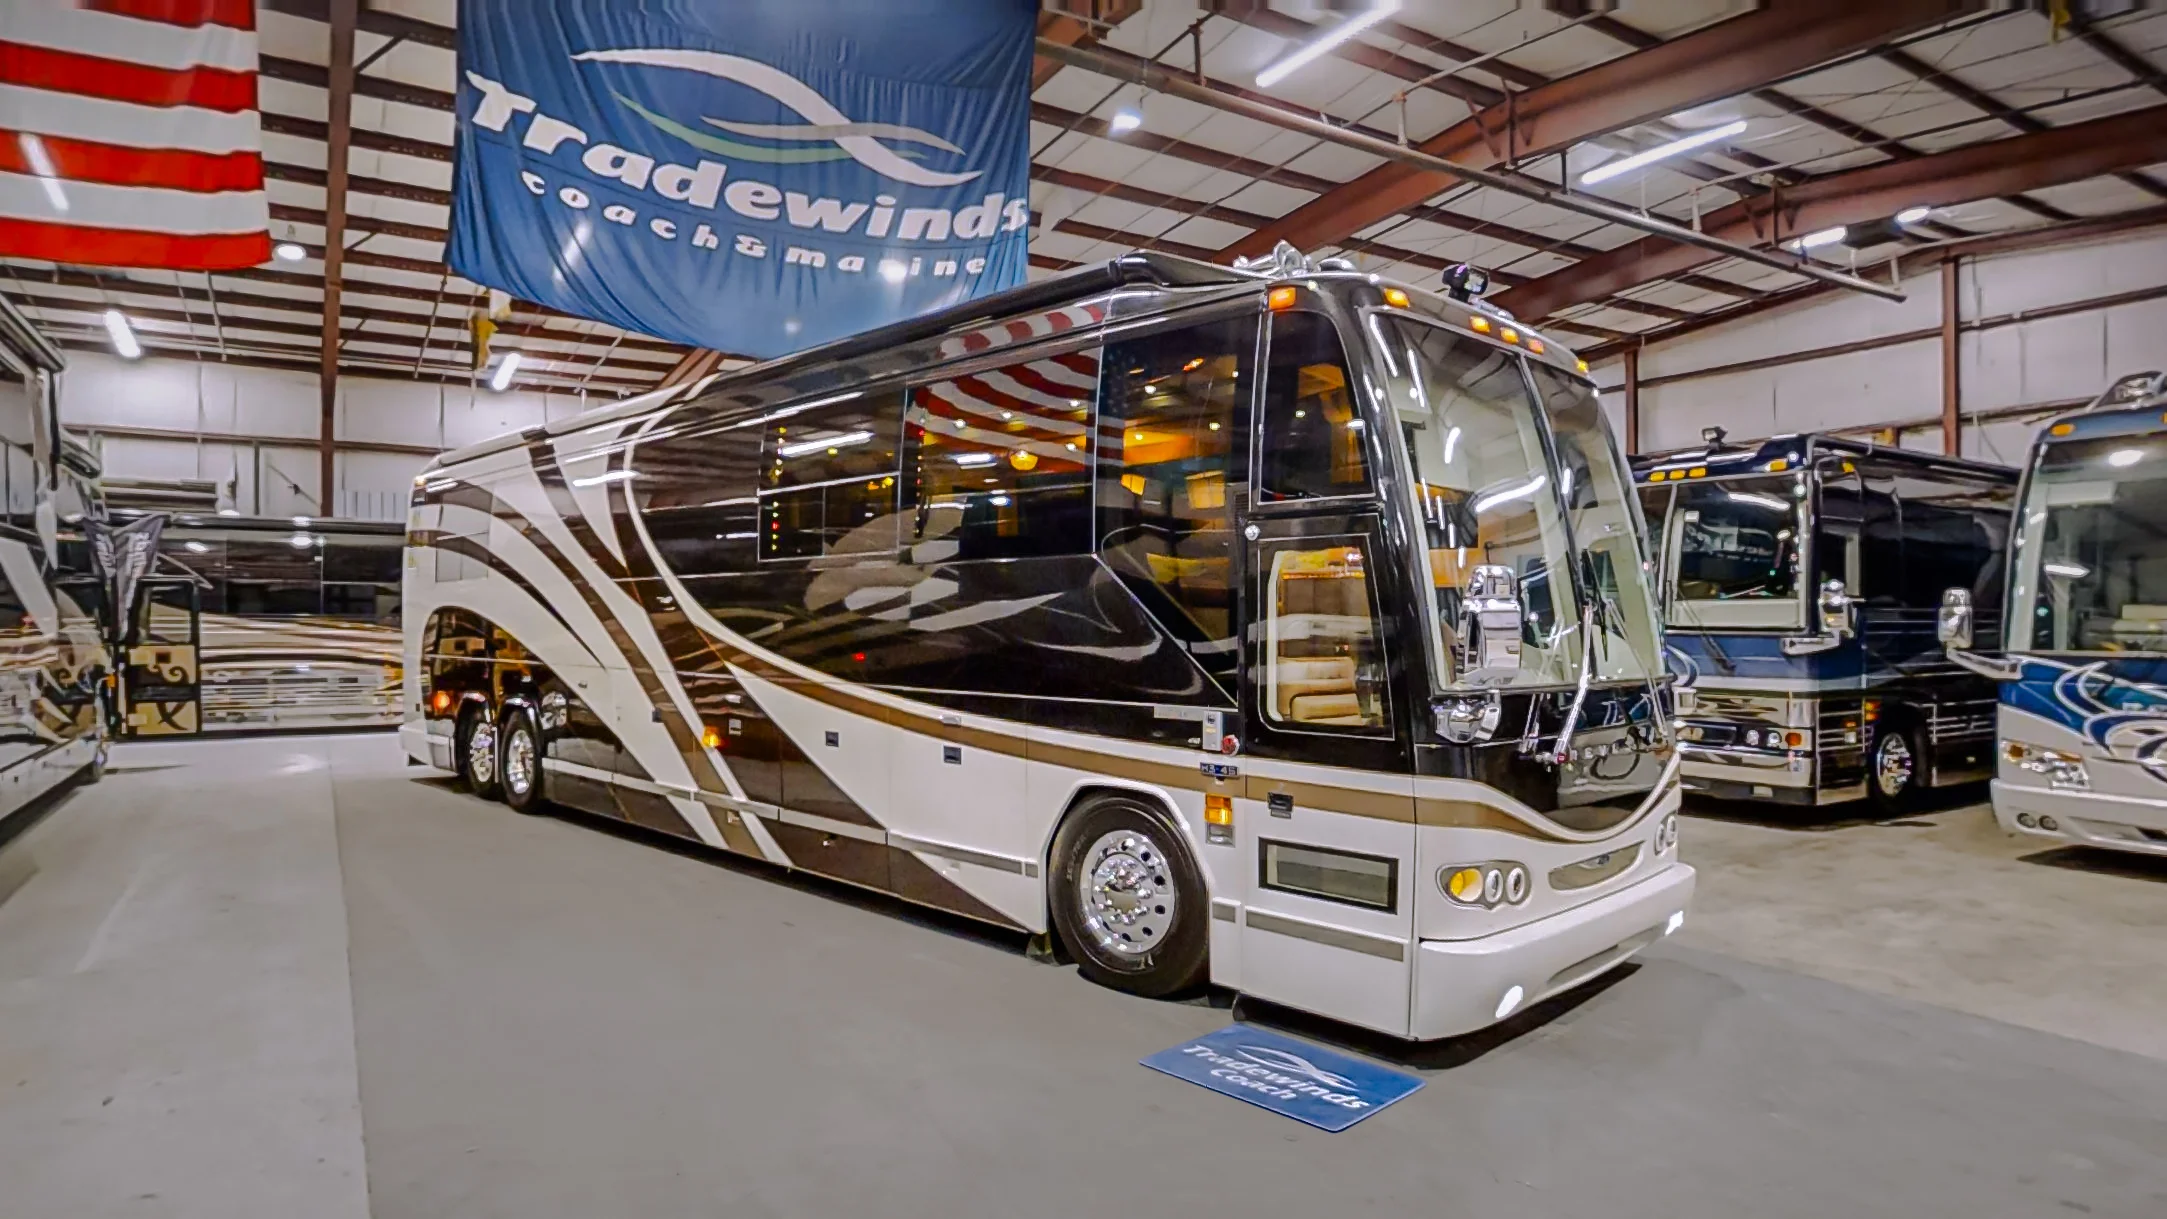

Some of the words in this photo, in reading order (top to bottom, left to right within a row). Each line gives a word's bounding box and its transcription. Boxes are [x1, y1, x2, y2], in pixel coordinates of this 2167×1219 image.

[465, 69, 1029, 241] Tradewinds
[1183, 1044, 1370, 1109] Tradewinds
[1210, 1068, 1297, 1100] Coach
